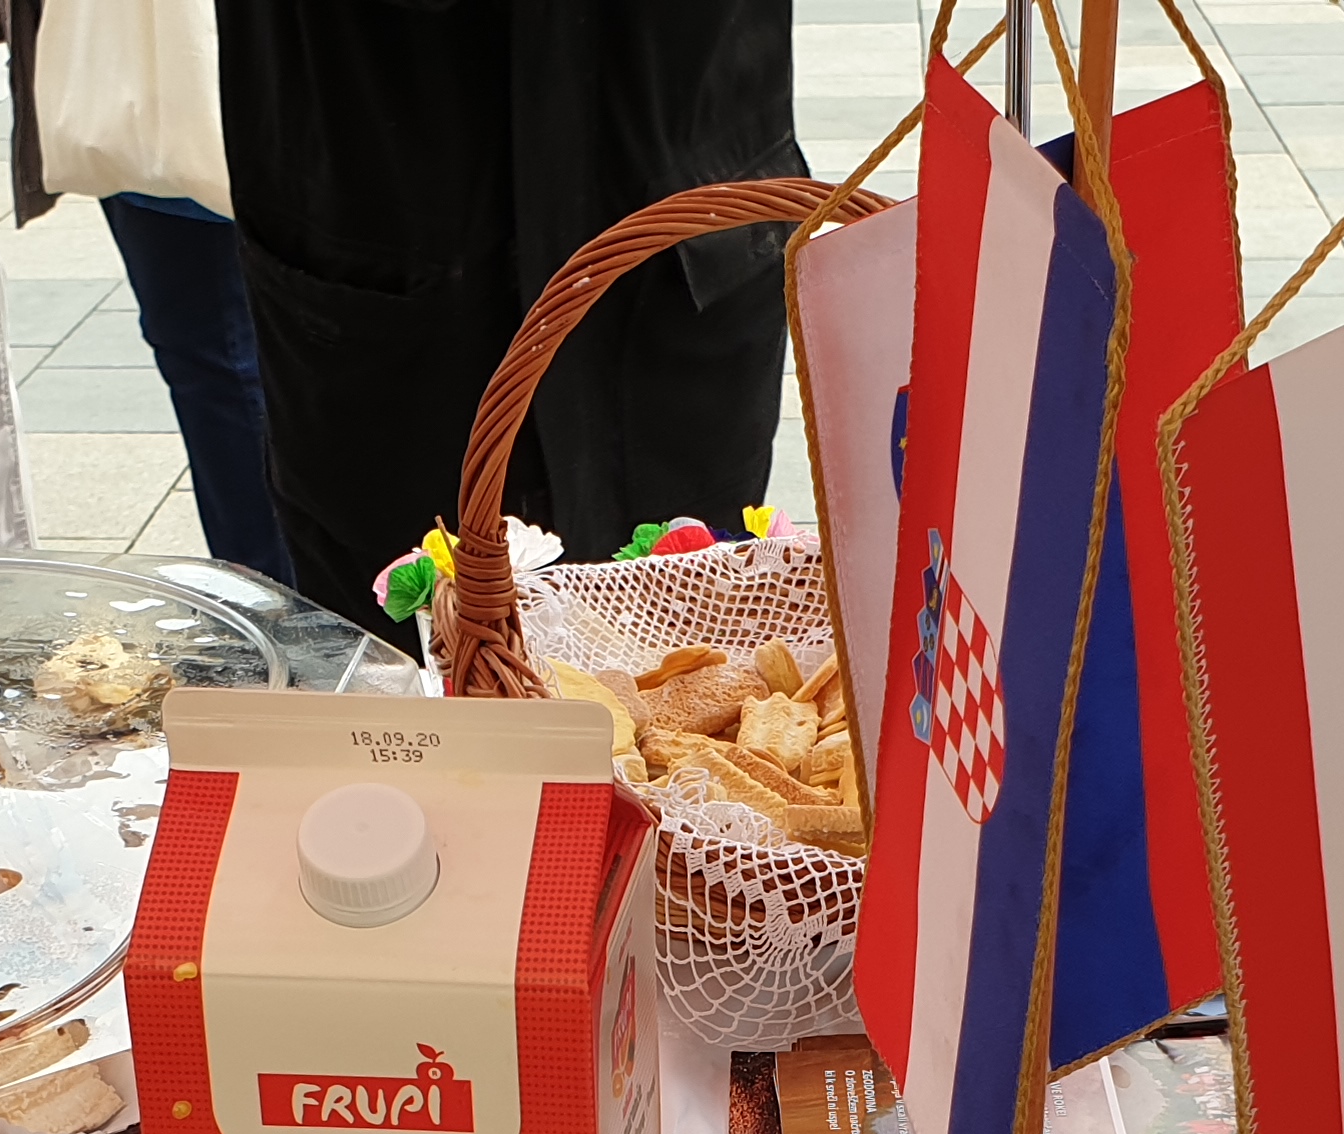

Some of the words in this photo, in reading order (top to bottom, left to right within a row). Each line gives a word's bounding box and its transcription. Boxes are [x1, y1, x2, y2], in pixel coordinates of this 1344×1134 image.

[350, 731, 441, 748] 18.09.20
[369, 749, 424, 763] 15:39
[861, 1069, 877, 1114] ZGODOVINA
[1053, 1095, 1067, 1118] ROKE!
[825, 1111, 842, 1131] uspel
